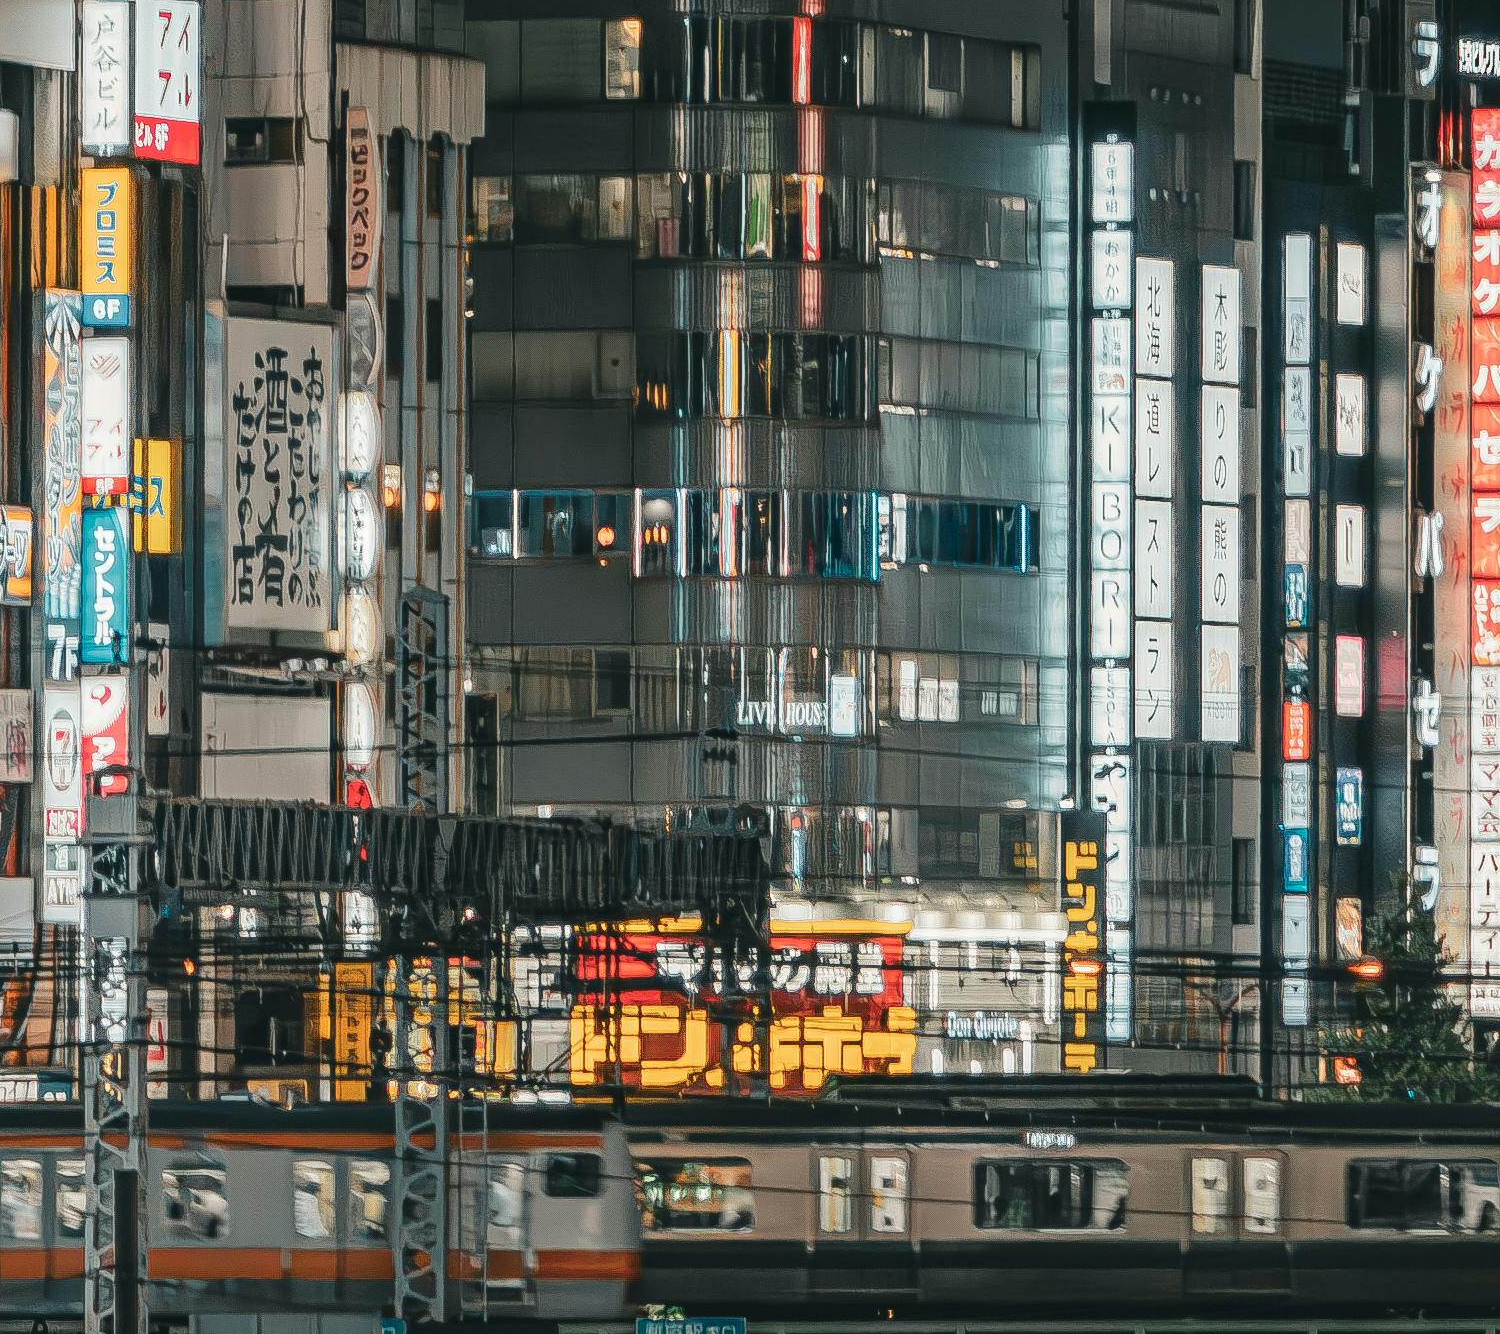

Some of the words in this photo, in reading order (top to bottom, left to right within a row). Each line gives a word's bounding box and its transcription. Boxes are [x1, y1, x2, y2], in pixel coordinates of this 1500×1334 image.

[91, 13, 121, 131] 戸谷ビル
[95, 180, 119, 284] プロミス
[1145, 275, 1166, 724] 北海道レストラン
[93, 525, 117, 646] セントラル
[1478, 763, 1500, 834] ママ会
[48, 878, 79, 906] ATM
